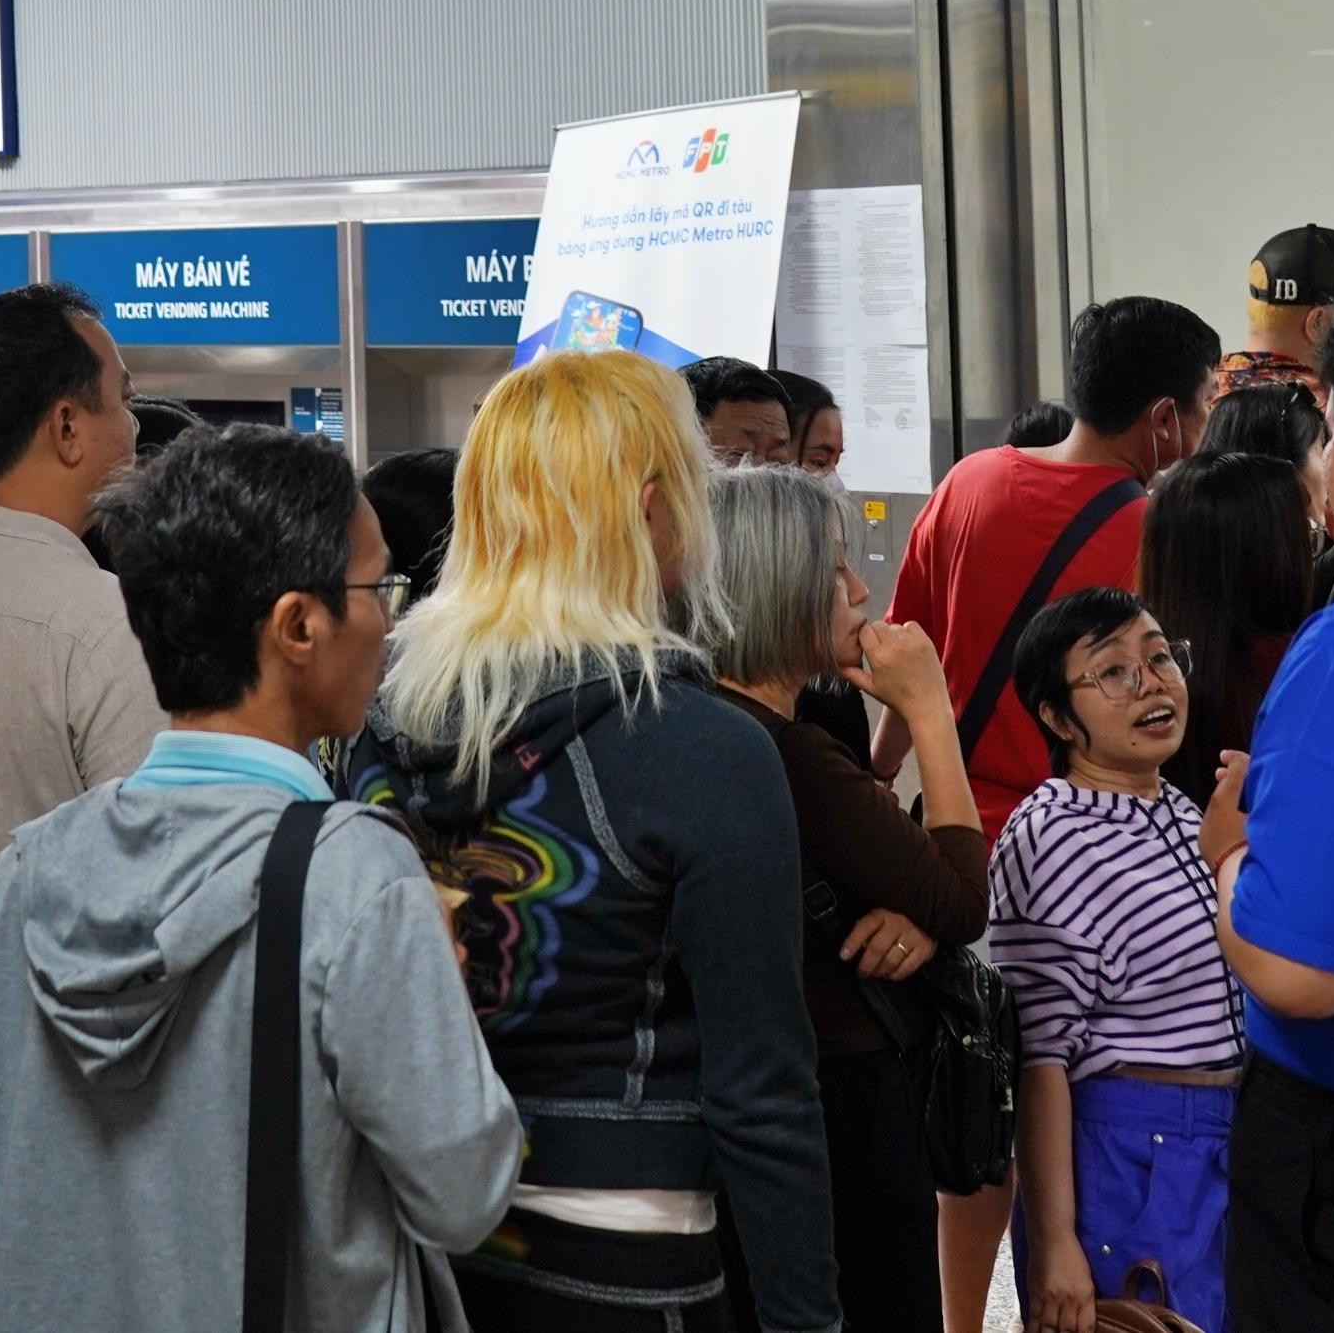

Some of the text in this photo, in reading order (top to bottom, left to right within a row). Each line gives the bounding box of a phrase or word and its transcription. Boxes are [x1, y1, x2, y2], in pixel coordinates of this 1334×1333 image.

[682, 128, 730, 174] FPT
[638, 165, 671, 178] METRO
[692, 201, 714, 218] QR
[648, 229, 690, 247] HCMC
[692, 225, 734, 243] Metro
[737, 220, 774, 238] HURC
[135, 255, 251, 288] MÁY BÁN VÉ
[466, 249, 517, 283] MÁY
[114, 300, 270, 319] TICKET VENDING MACHINE
[440, 299, 527, 317] TICKET VEND
